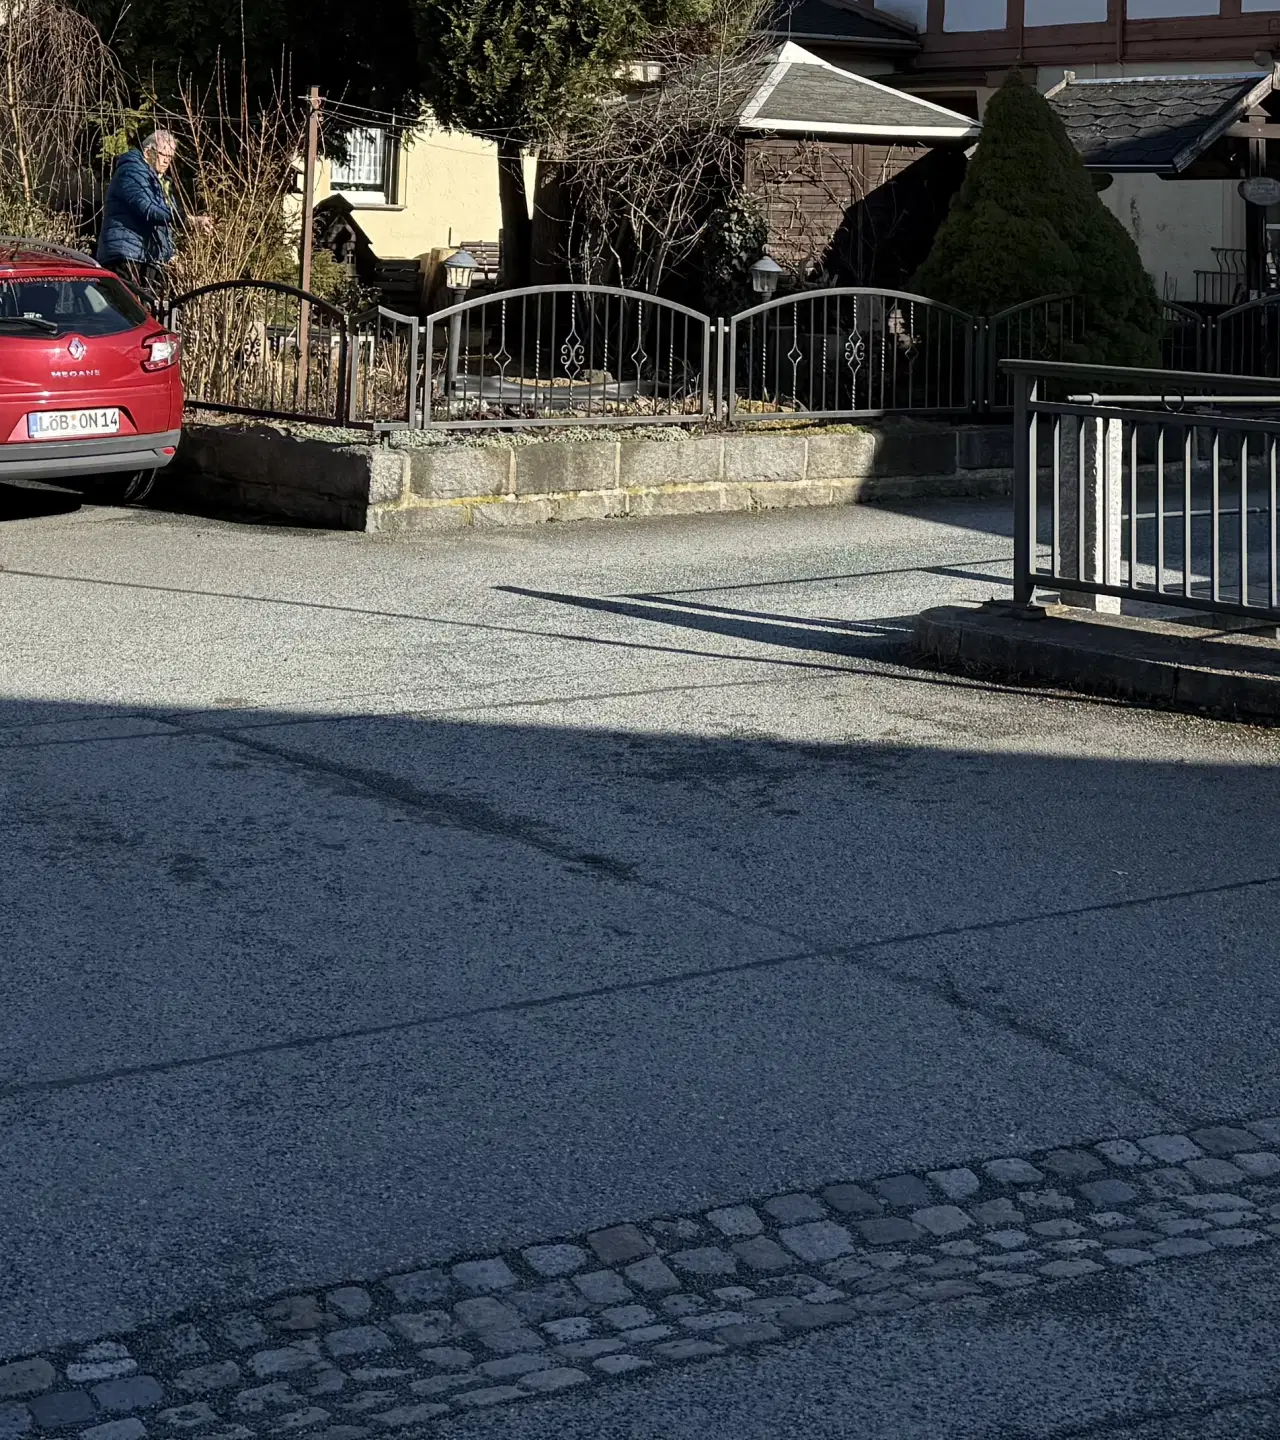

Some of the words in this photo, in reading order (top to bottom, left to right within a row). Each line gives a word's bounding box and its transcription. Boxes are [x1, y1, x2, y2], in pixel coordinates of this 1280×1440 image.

[50, 369, 101, 378] MEGANE
[79, 412, 98, 429] ON
[101, 411, 118, 428] 14
